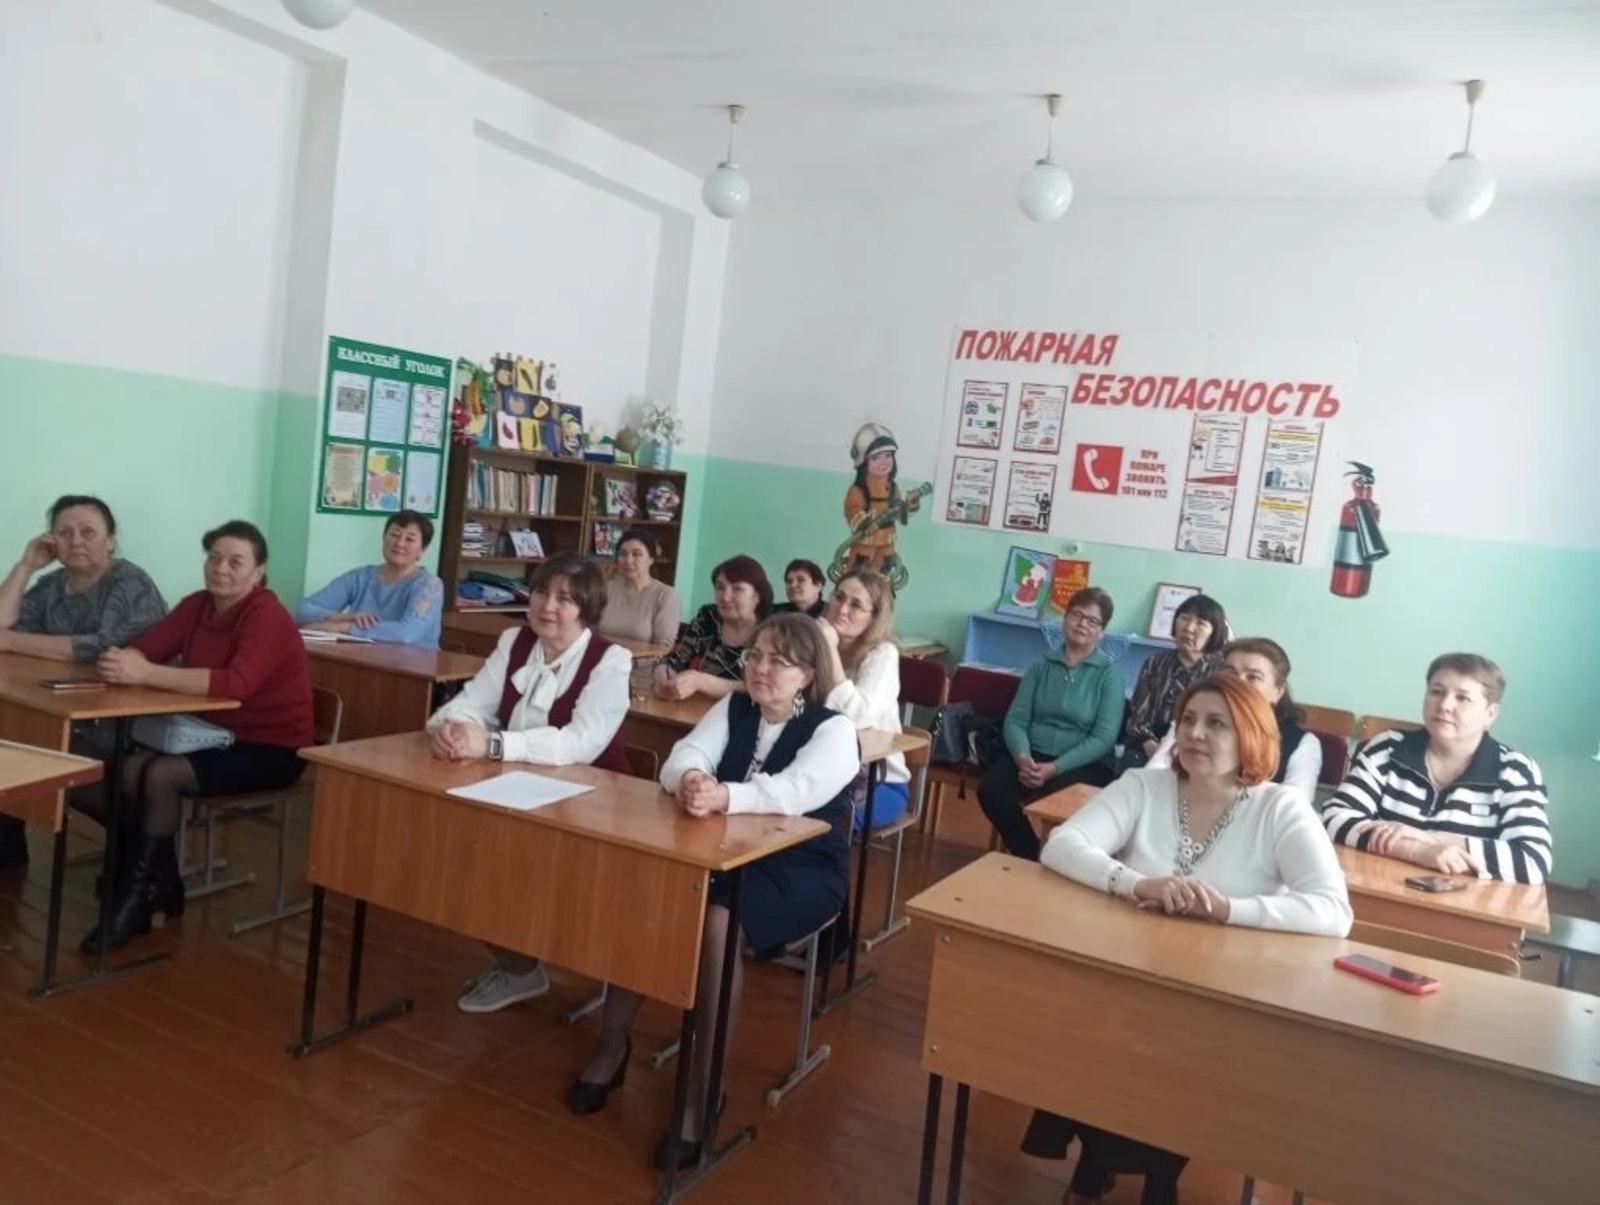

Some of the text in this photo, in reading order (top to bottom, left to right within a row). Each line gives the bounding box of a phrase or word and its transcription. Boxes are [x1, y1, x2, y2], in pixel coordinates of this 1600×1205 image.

[337, 346, 445, 378] КЛАССНЫЙ УГОЛОК
[955, 330, 1119, 366] ПОЖАРНАЯ
[1071, 373, 1341, 418] БЕЗОПАСНОСТЬ
[1140, 450, 1158, 459] ПРИ
